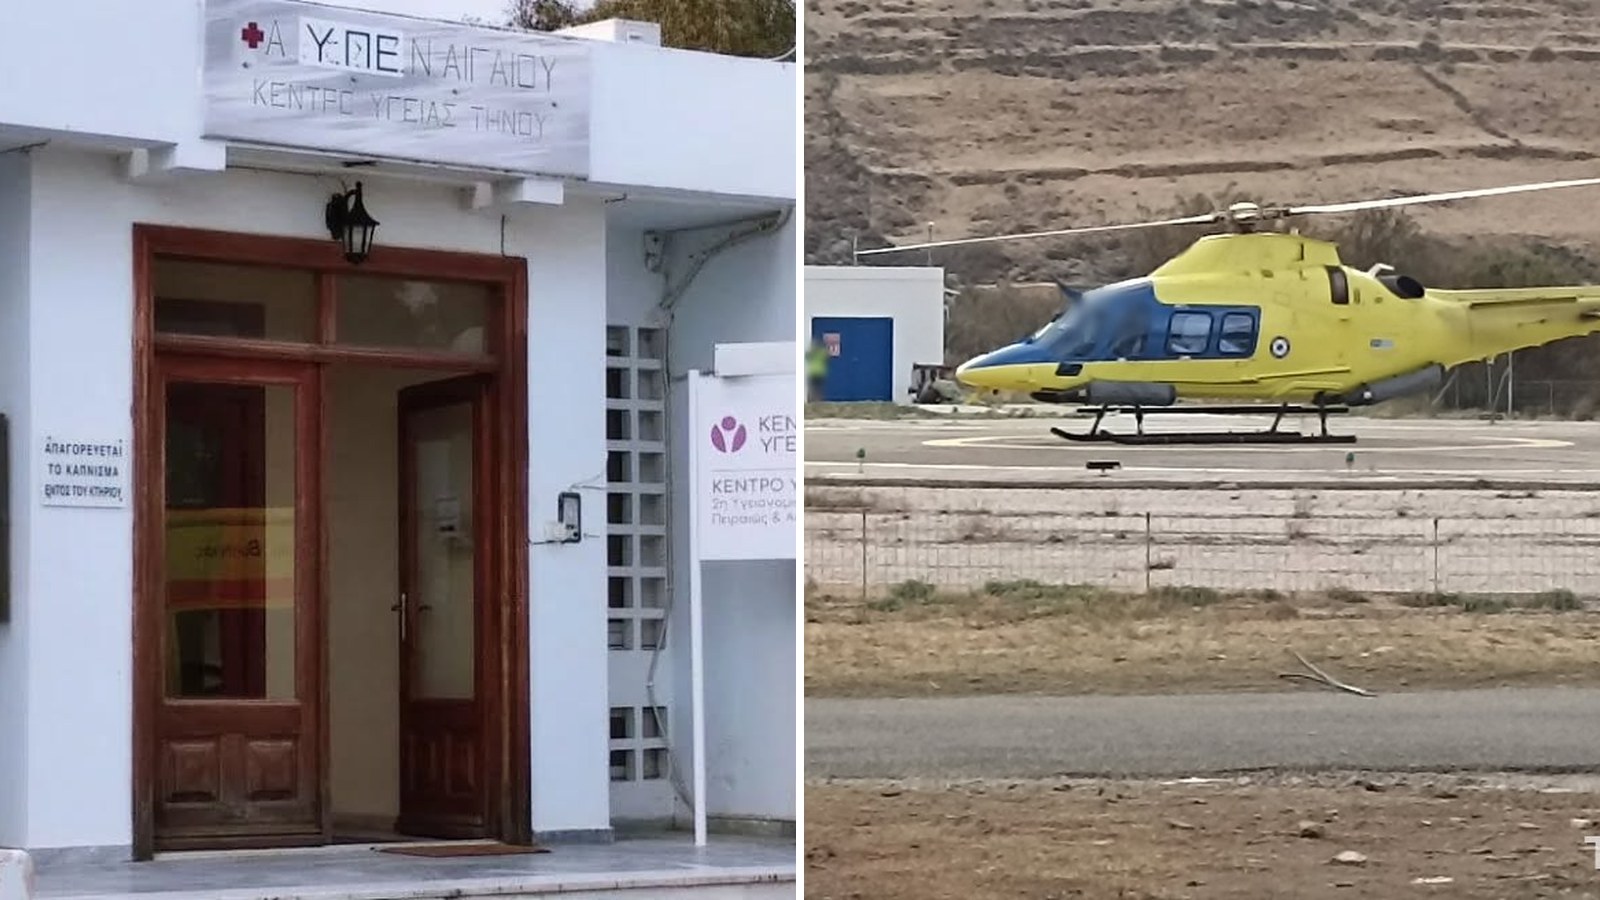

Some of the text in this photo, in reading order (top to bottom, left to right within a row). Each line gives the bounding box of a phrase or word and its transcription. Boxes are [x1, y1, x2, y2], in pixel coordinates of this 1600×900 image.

[470, 105, 548, 138] ΤΗΝΟΥ
[45, 443, 122, 456] ΑΠΑΓΟΡΕΥΕΤΑΙ
[48, 463, 119, 478] ΤΟ ΚΑΠΝΙΣΜΑ
[45, 484, 71, 498] ΕΝΤΟΣ
[73, 484, 87, 497] ΤΟΥ
[712, 477, 784, 494] ΚΕΝΤΡΟ
